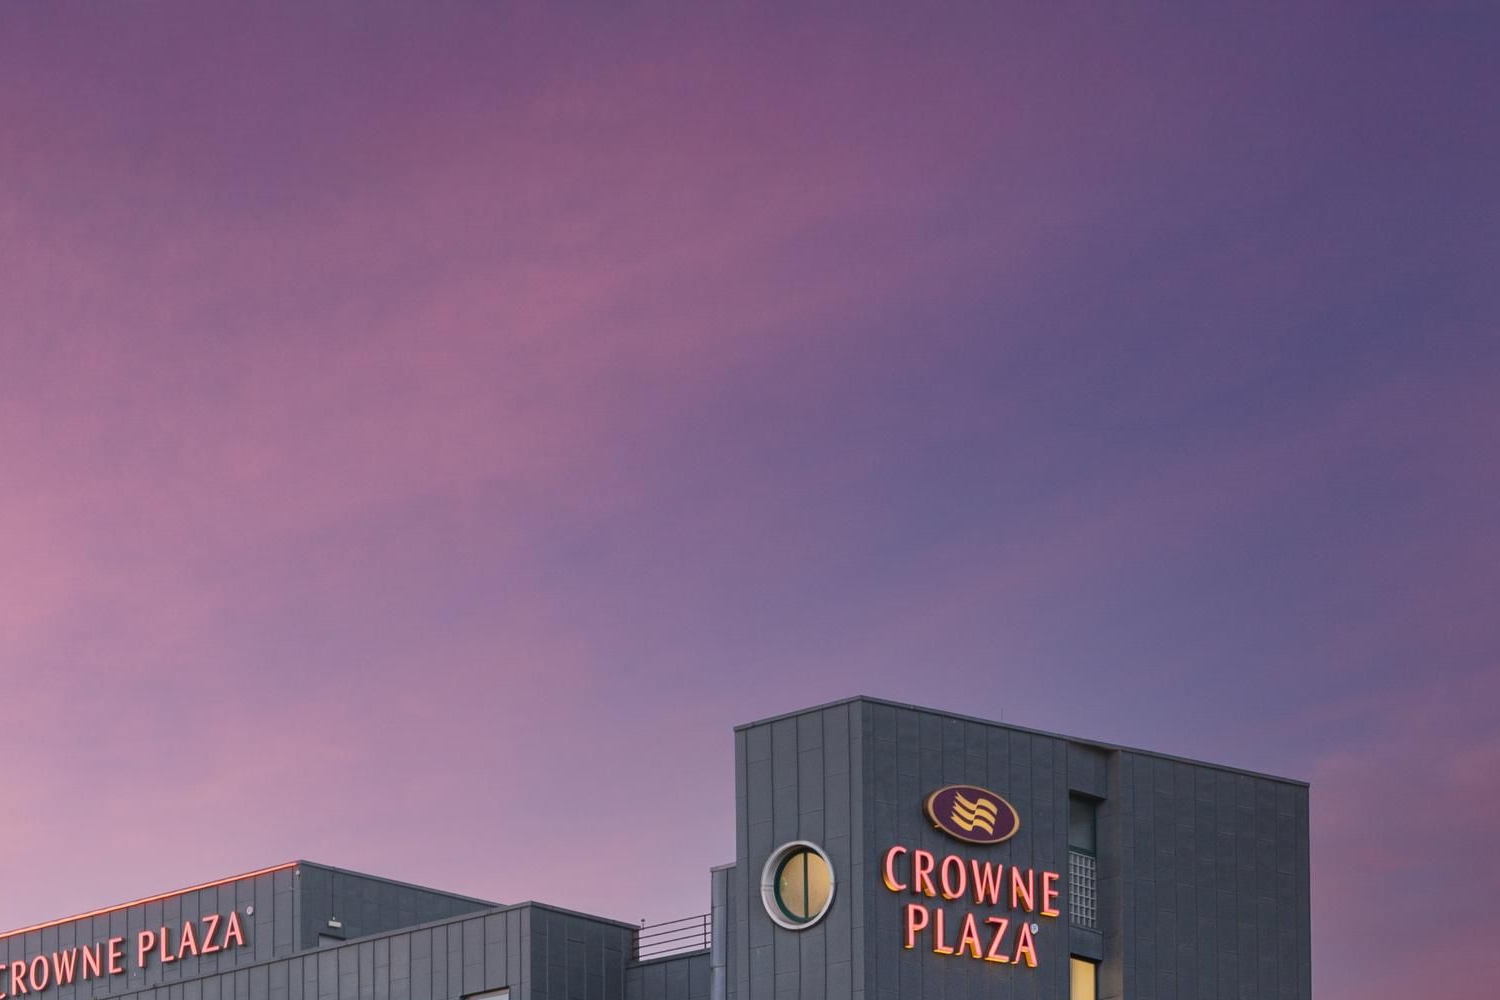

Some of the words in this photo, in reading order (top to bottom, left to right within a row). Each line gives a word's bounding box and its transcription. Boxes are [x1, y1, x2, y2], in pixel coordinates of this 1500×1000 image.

[883, 845, 1060, 917] CROWNE
[137, 911, 246, 969] PLAZA
[903, 903, 1038, 968] PLAZA
